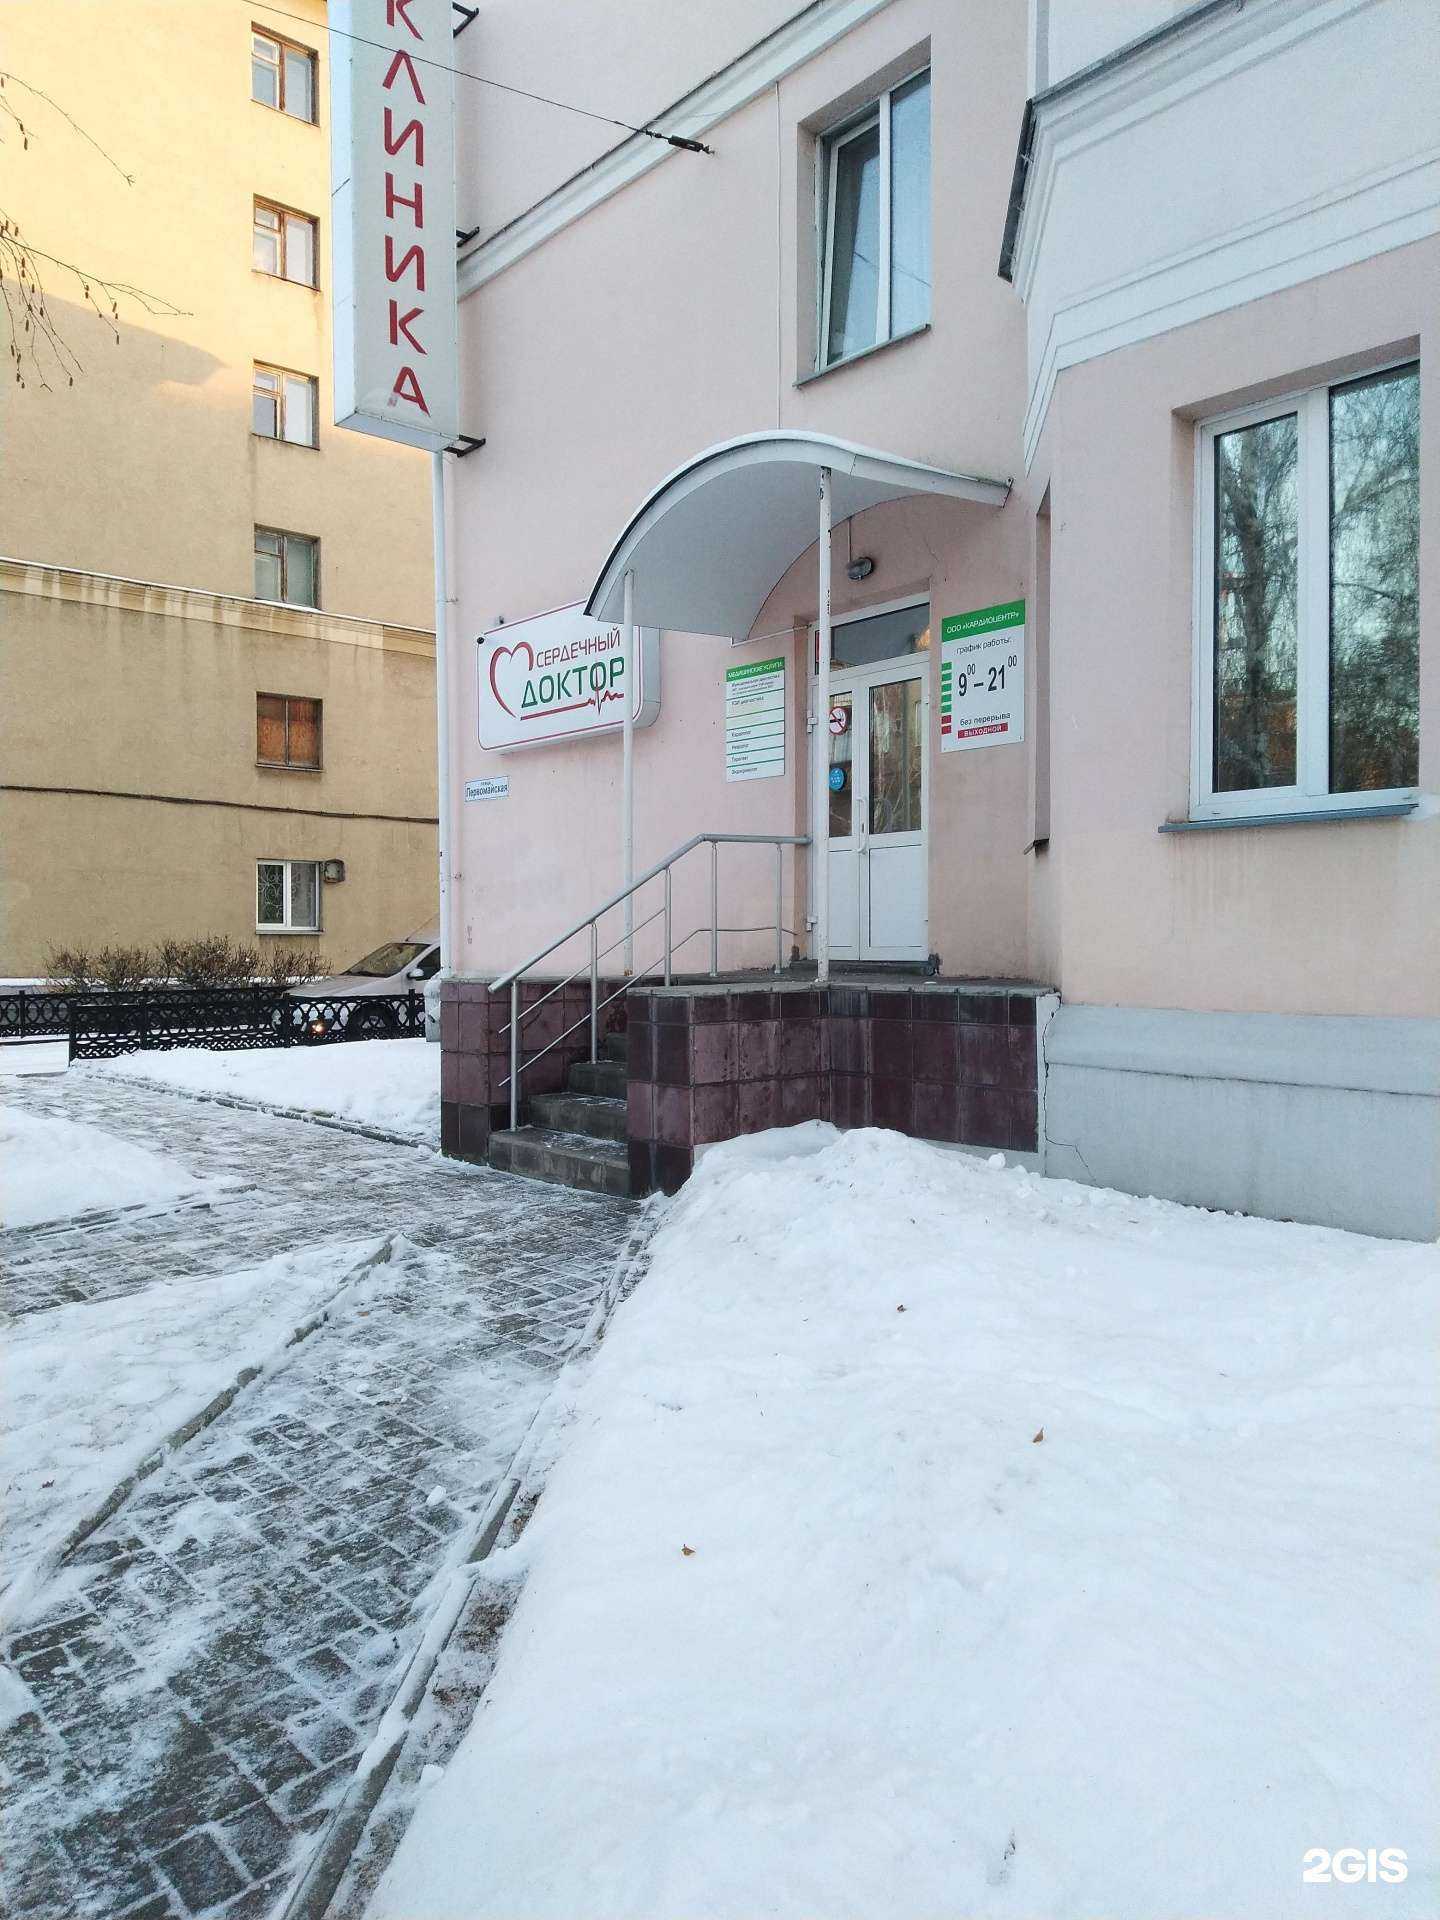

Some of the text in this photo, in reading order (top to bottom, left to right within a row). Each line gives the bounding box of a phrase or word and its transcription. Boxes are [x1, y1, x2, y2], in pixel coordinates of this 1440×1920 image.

[382, 0, 431, 418] КЛИНИКА
[947, 625, 961, 633] ООО
[536, 626, 620, 668] СЕРДЕЧНЫЙ
[957, 643, 981, 654] график
[521, 656, 625, 708] ДОКТОР
[960, 713, 1011, 726] без перерыва
[467, 785, 508, 798] Первомайская
